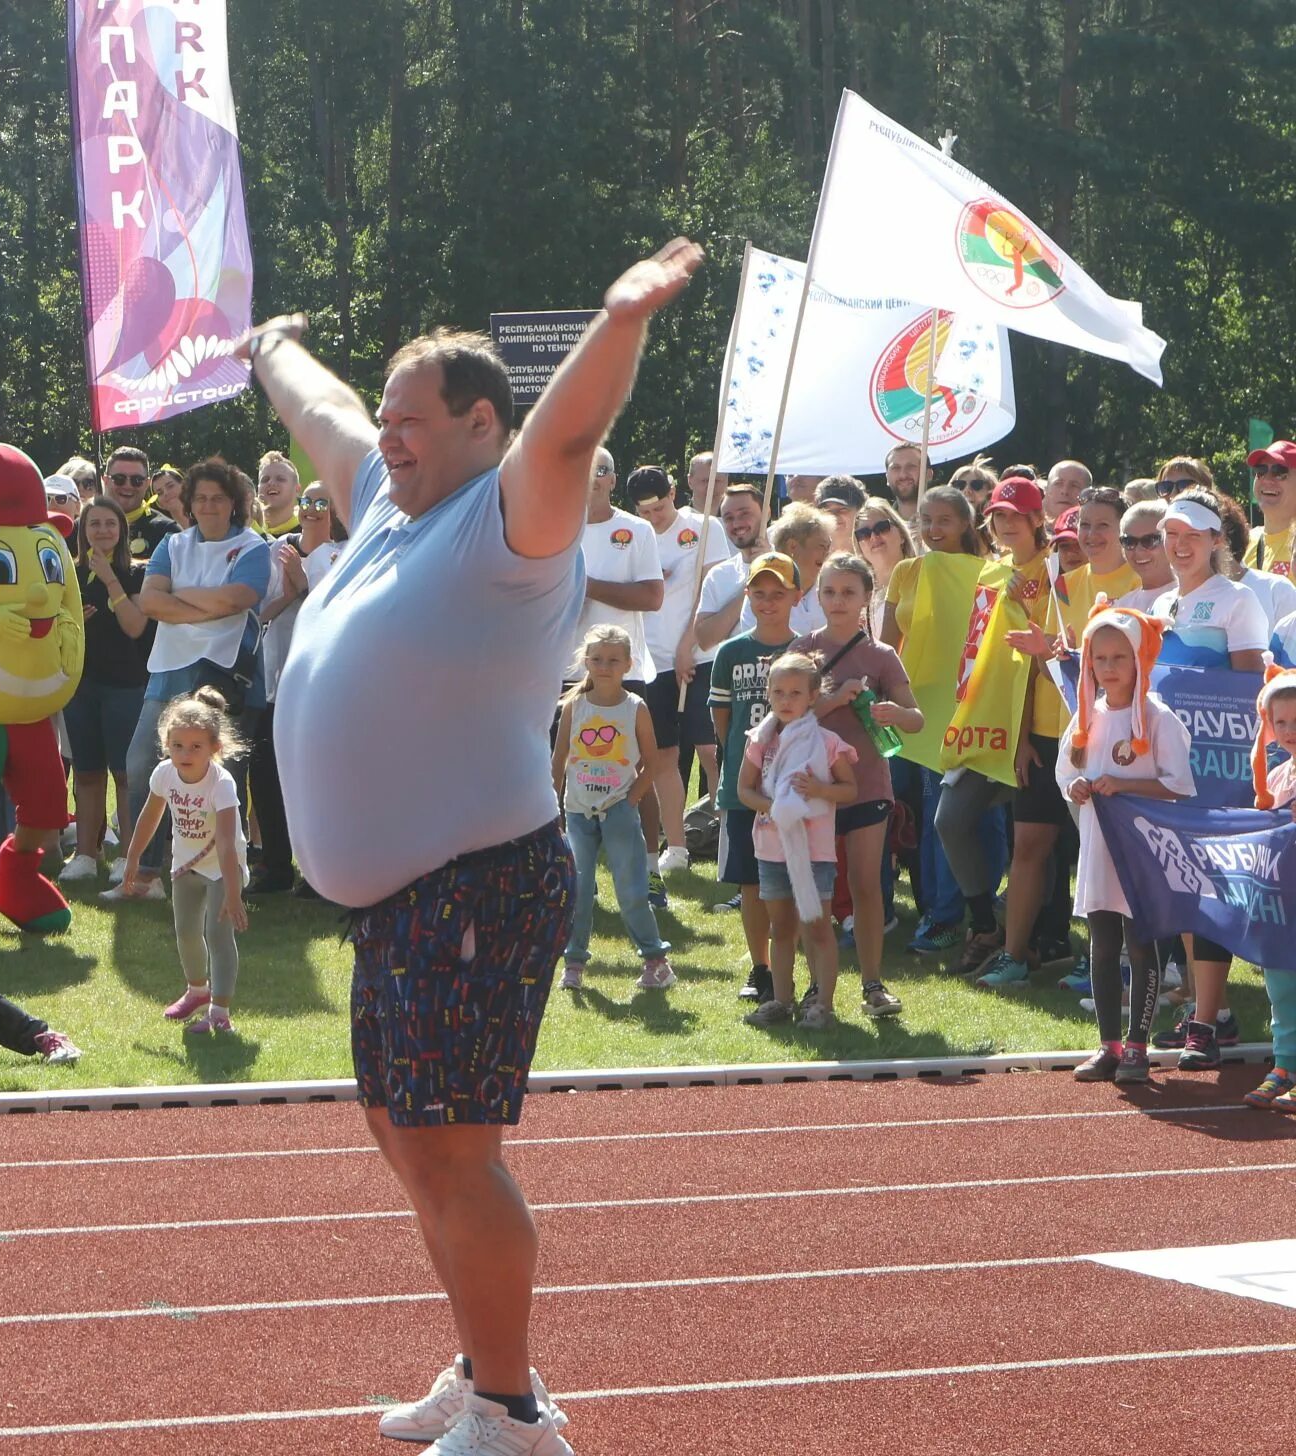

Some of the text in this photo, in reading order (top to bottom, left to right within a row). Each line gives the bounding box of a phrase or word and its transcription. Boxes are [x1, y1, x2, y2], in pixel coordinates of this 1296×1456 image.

[173, 0, 209, 102] RK
[100, 0, 146, 229] ПАРК
[533, 344, 545, 352] ПО
